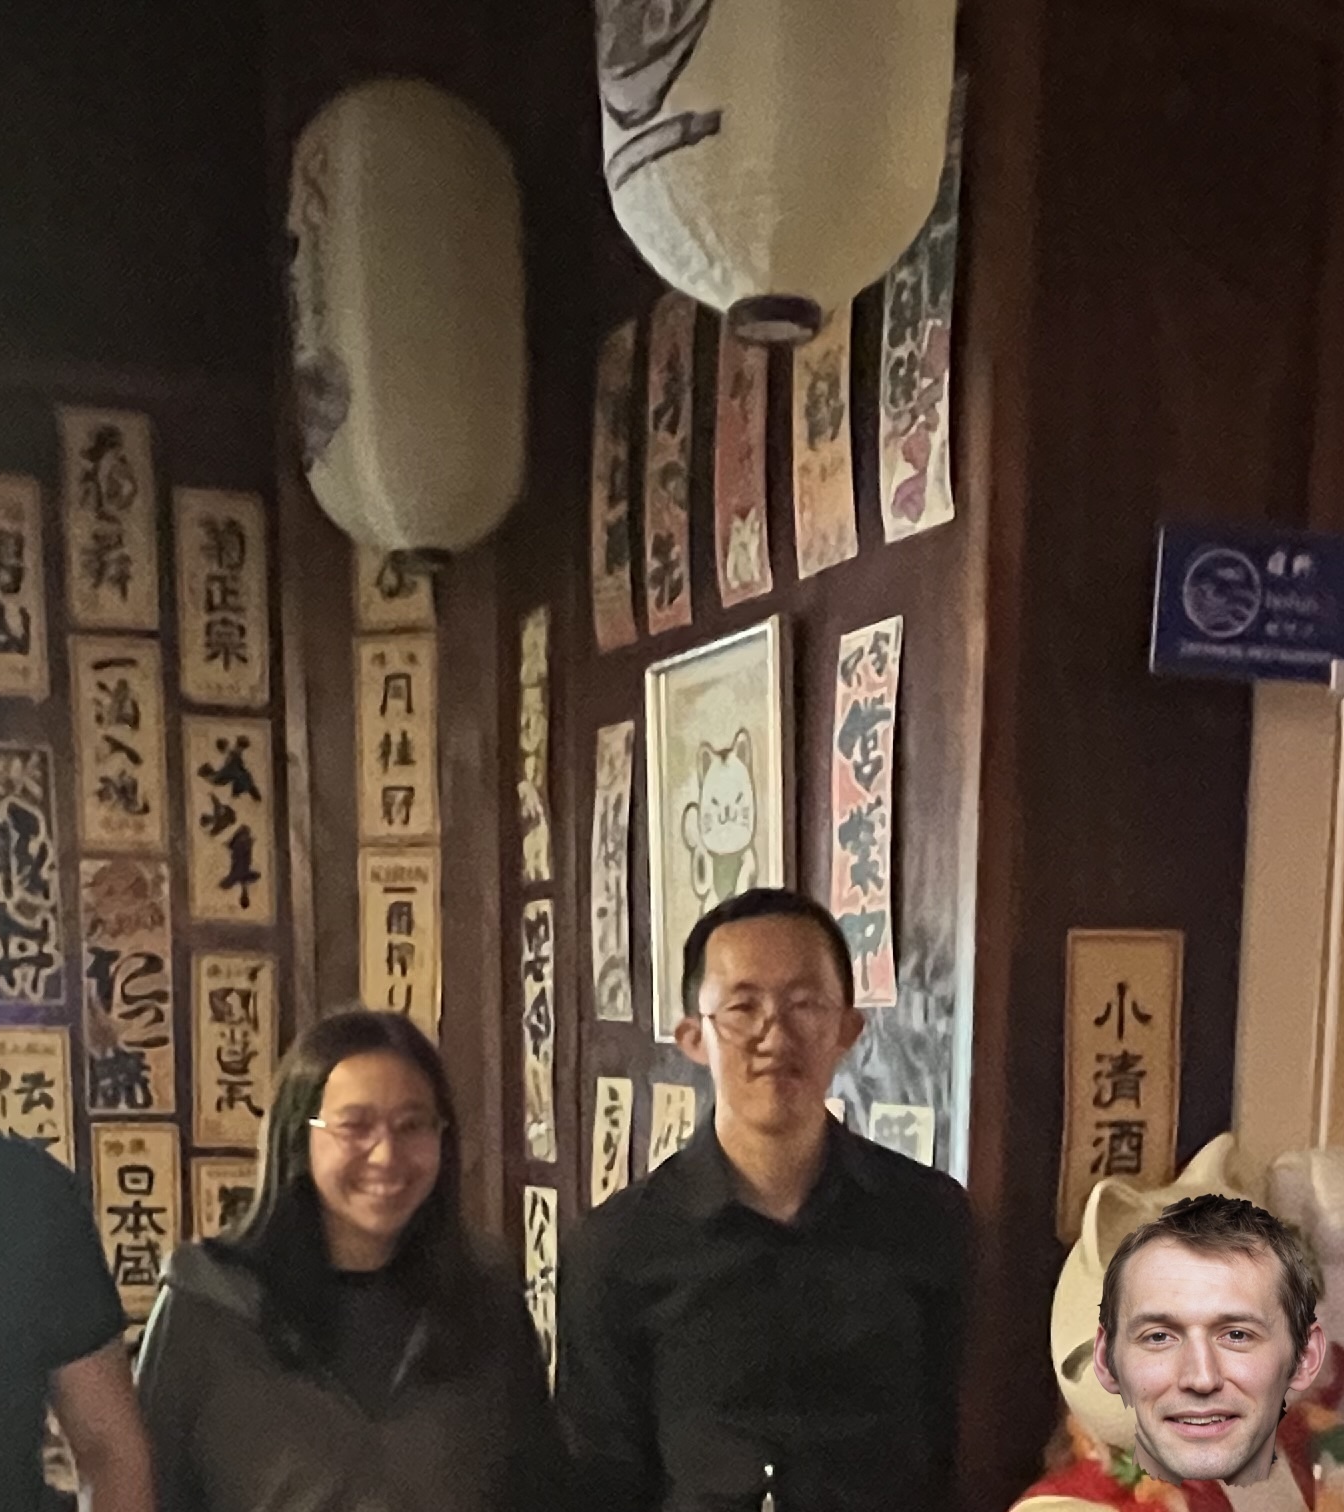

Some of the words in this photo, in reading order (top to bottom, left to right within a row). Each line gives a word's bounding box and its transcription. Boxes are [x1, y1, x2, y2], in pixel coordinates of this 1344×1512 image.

[1090, 981, 1153, 1177] 小清酒
[107, 1164, 168, 1288] 日本盛
